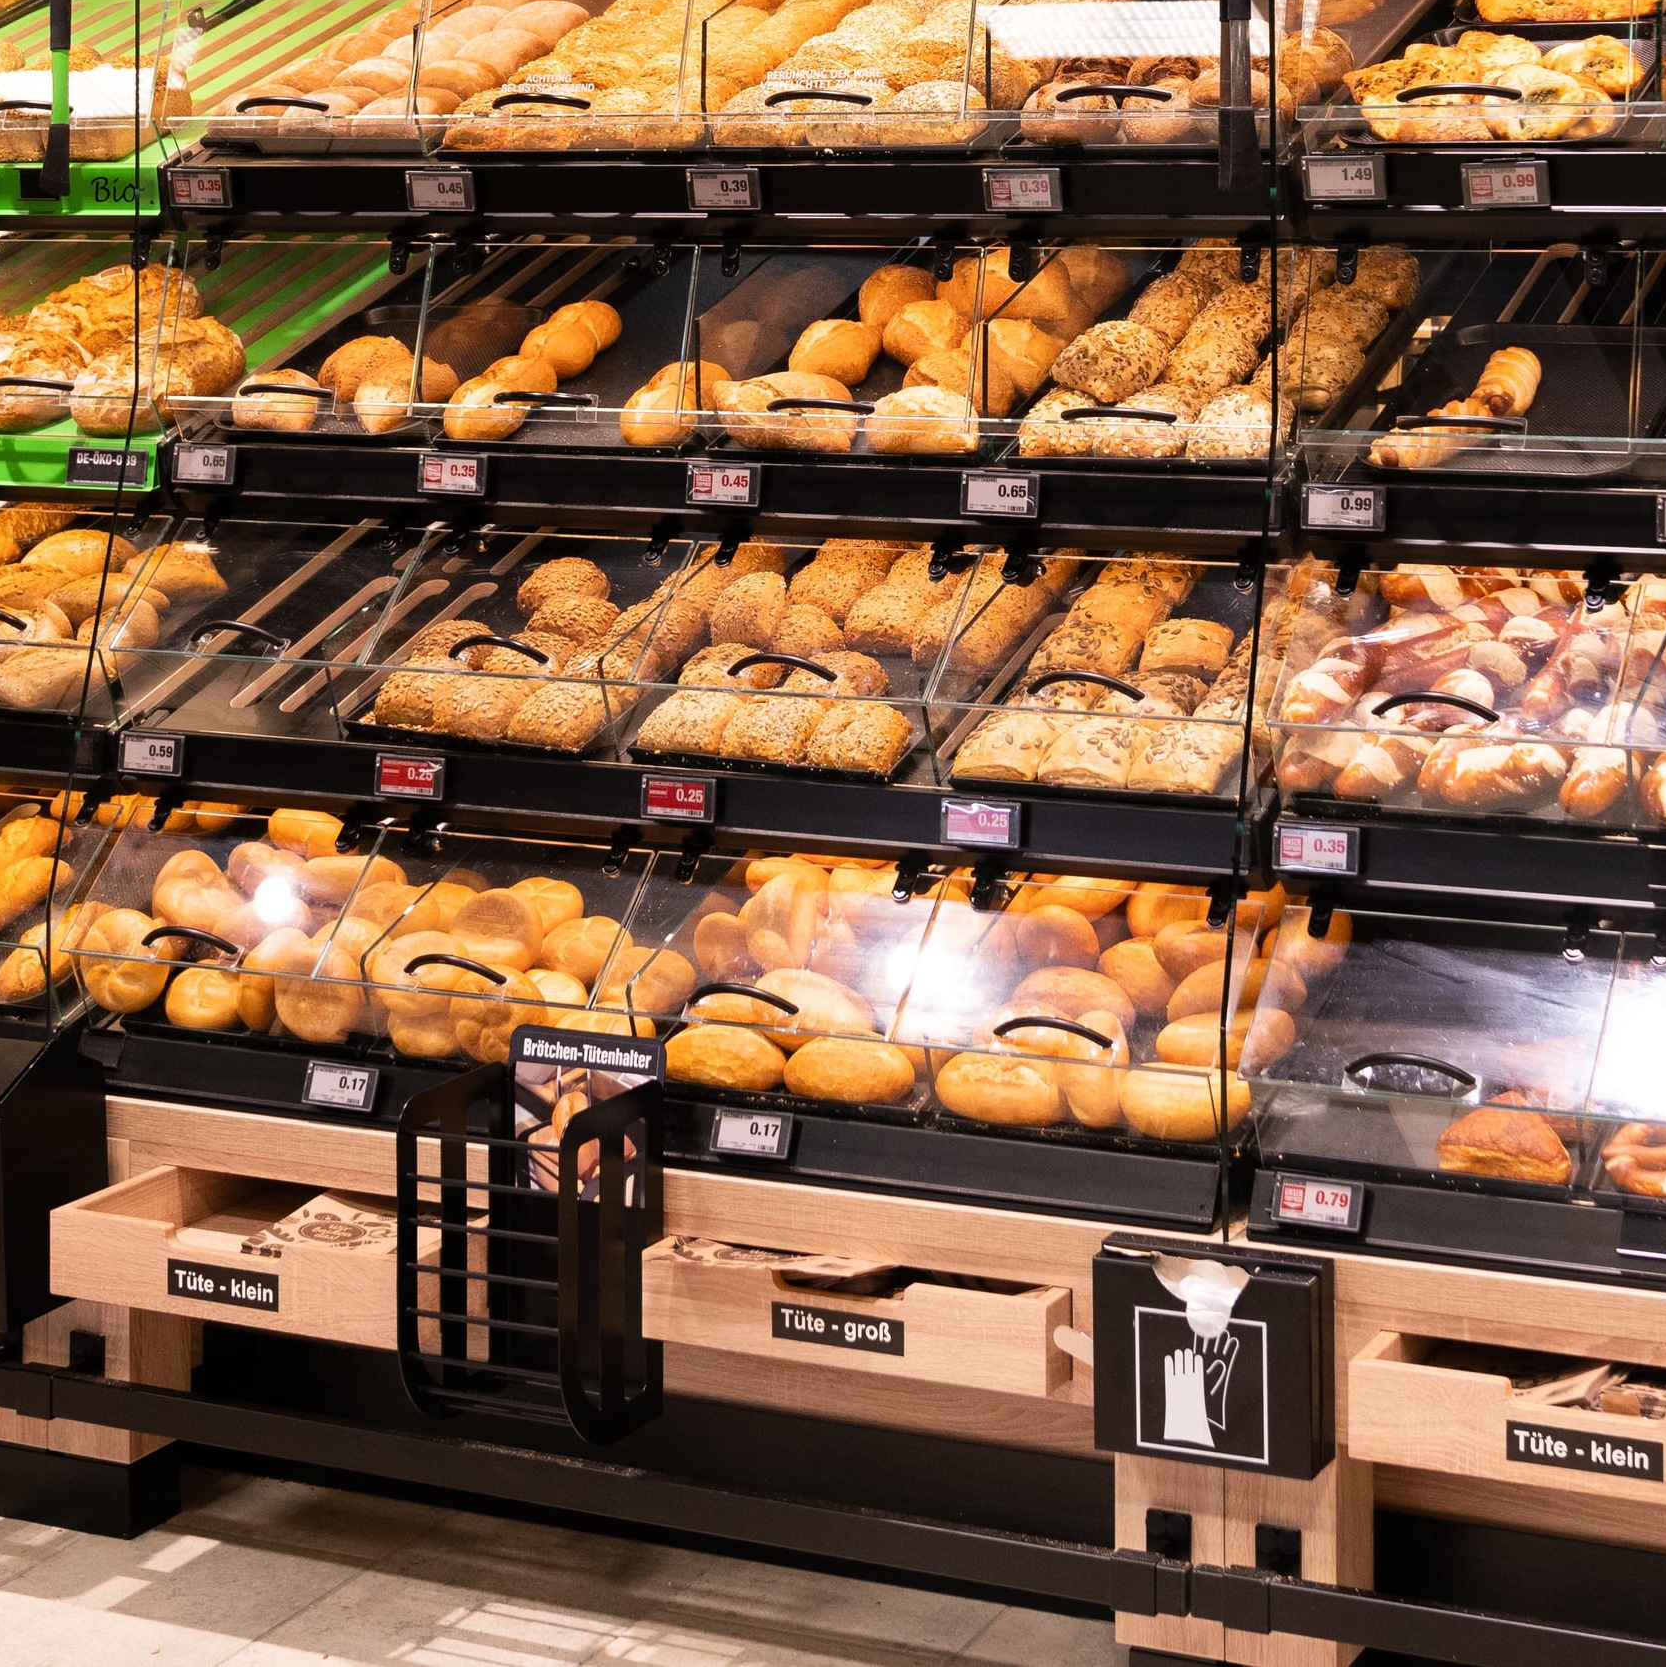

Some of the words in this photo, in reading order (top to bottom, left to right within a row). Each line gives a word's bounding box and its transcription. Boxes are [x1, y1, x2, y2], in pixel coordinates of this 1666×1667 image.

[525, 74, 573, 84] ACHTUNG
[1341, 167, 1373, 182] 1.49
[1502, 173, 1535, 189] 0.99
[91, 176, 146, 203] Bio
[196, 178, 222, 191] 0.35
[437, 180, 464, 194] 0.45
[720, 179, 748, 194] 0.39
[1019, 180, 1049, 194] 0.39
[202, 454, 226, 468] 0.65
[449, 464, 476, 478] 0.35
[720, 474, 749, 488] 0.45
[997, 484, 1027, 499] 0.65
[1340, 496, 1372, 512] 0.99
[148, 744, 174, 759] 0.59
[407, 766, 434, 782] 0.25
[675, 788, 704, 804] 0.25
[977, 812, 1009, 829] 0.25
[1313, 838, 1346, 854] 0.35
[523, 1037, 652, 1069] Brötchen-Tütenhalter
[338, 1075, 367, 1093] 0.17
[749, 1121, 780, 1138] 0.17
[1314, 1189, 1349, 1209] 0.79
[174, 1268, 215, 1294] Tüte
[231, 1278, 274, 1304] klein
[781, 1307, 826, 1333] Tüte
[844, 1321, 892, 1343] groß
[1513, 1429, 1568, 1459] Tüte
[1591, 1441, 1650, 1471] klein
